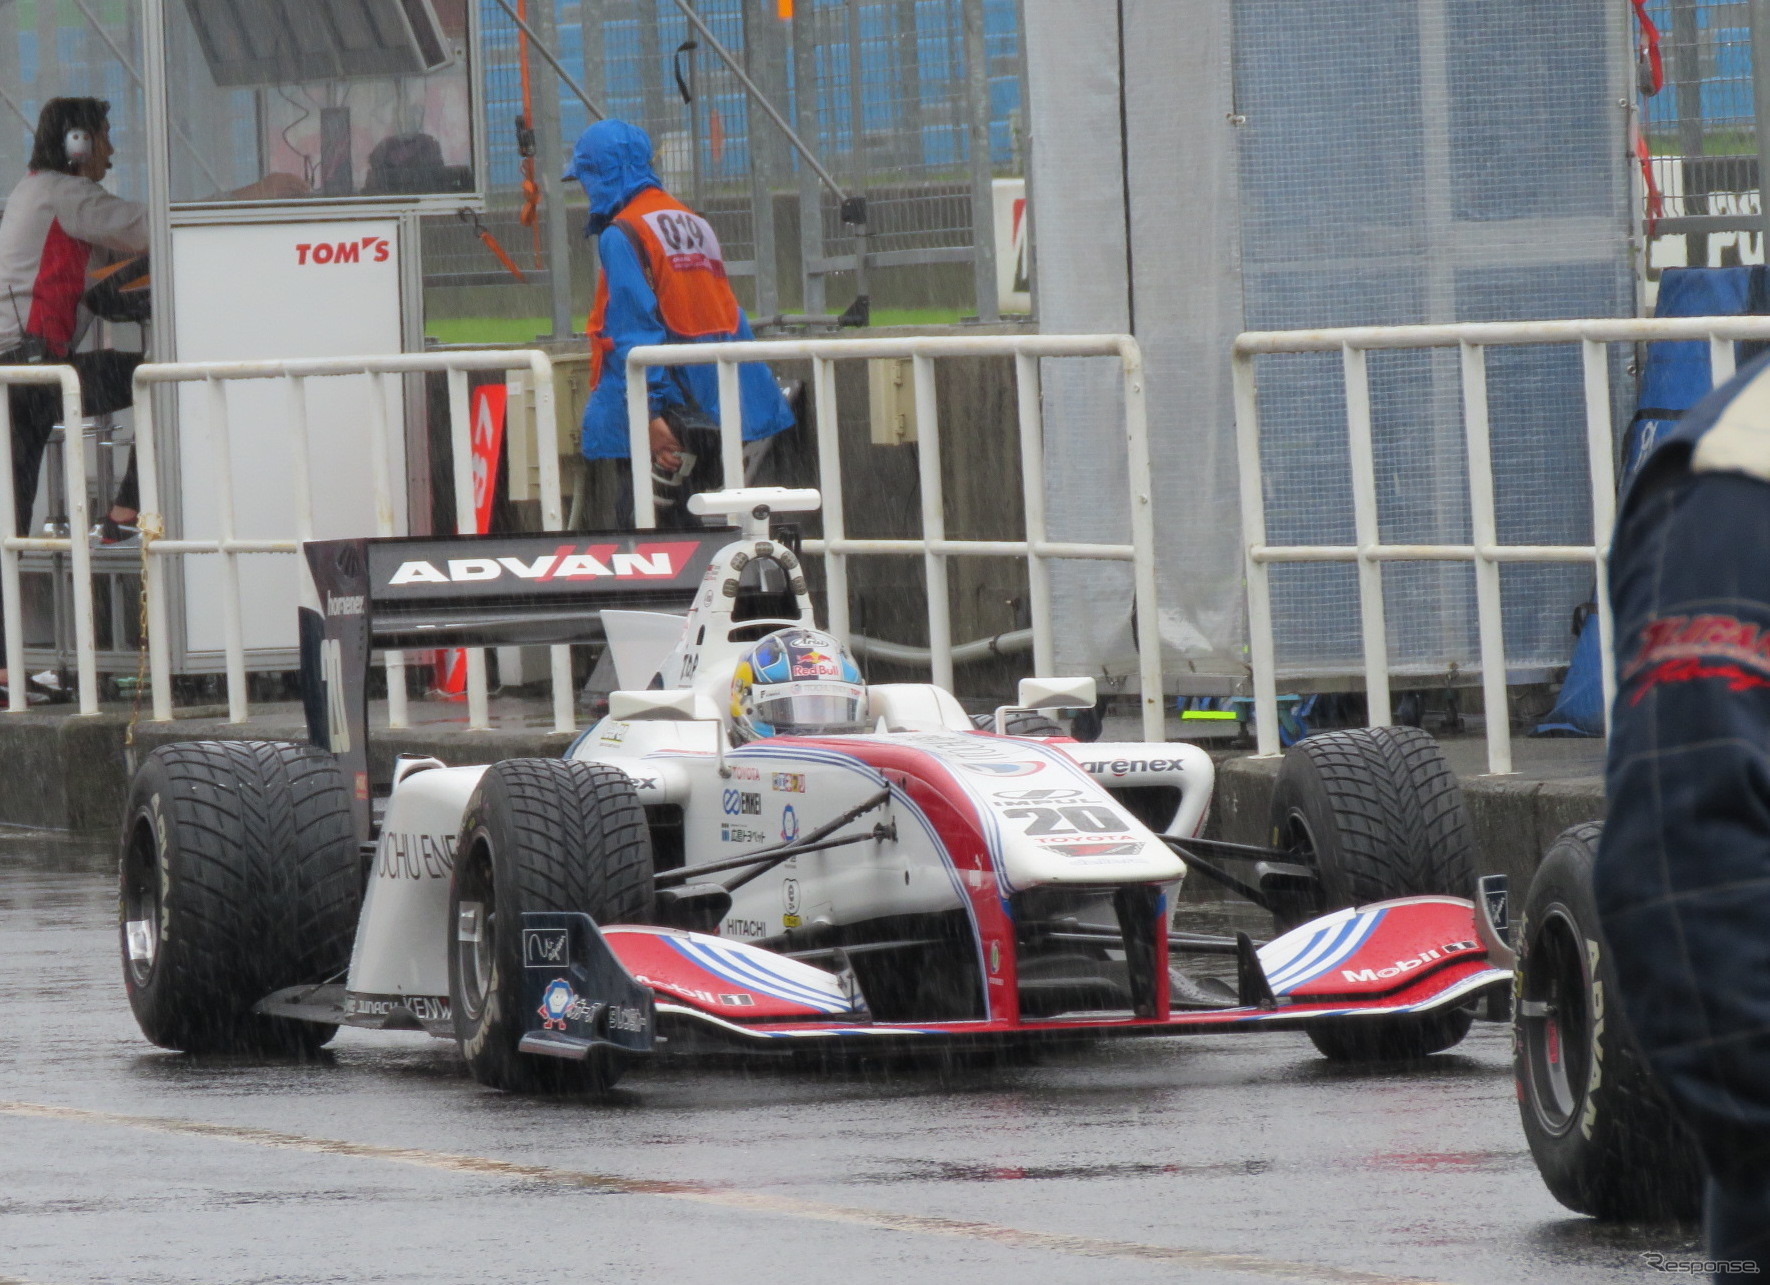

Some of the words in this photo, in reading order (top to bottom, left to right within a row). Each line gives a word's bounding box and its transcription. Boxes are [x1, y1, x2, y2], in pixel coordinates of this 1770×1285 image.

[656, 213, 704, 250] 019
[295, 237, 390, 265] TOM'S
[388, 552, 674, 584] ADVAN
[793, 665, 817, 677] Red
[819, 665, 839, 677] Bull
[993, 799, 1102, 807] IMPUL
[1003, 806, 1131, 836] 20
[1034, 834, 1137, 844] TOYOTA
[726, 919, 767, 937] HITACHI
[1341, 949, 1442, 983] Mobil
[1580, 938, 1604, 1141] ADVAN
